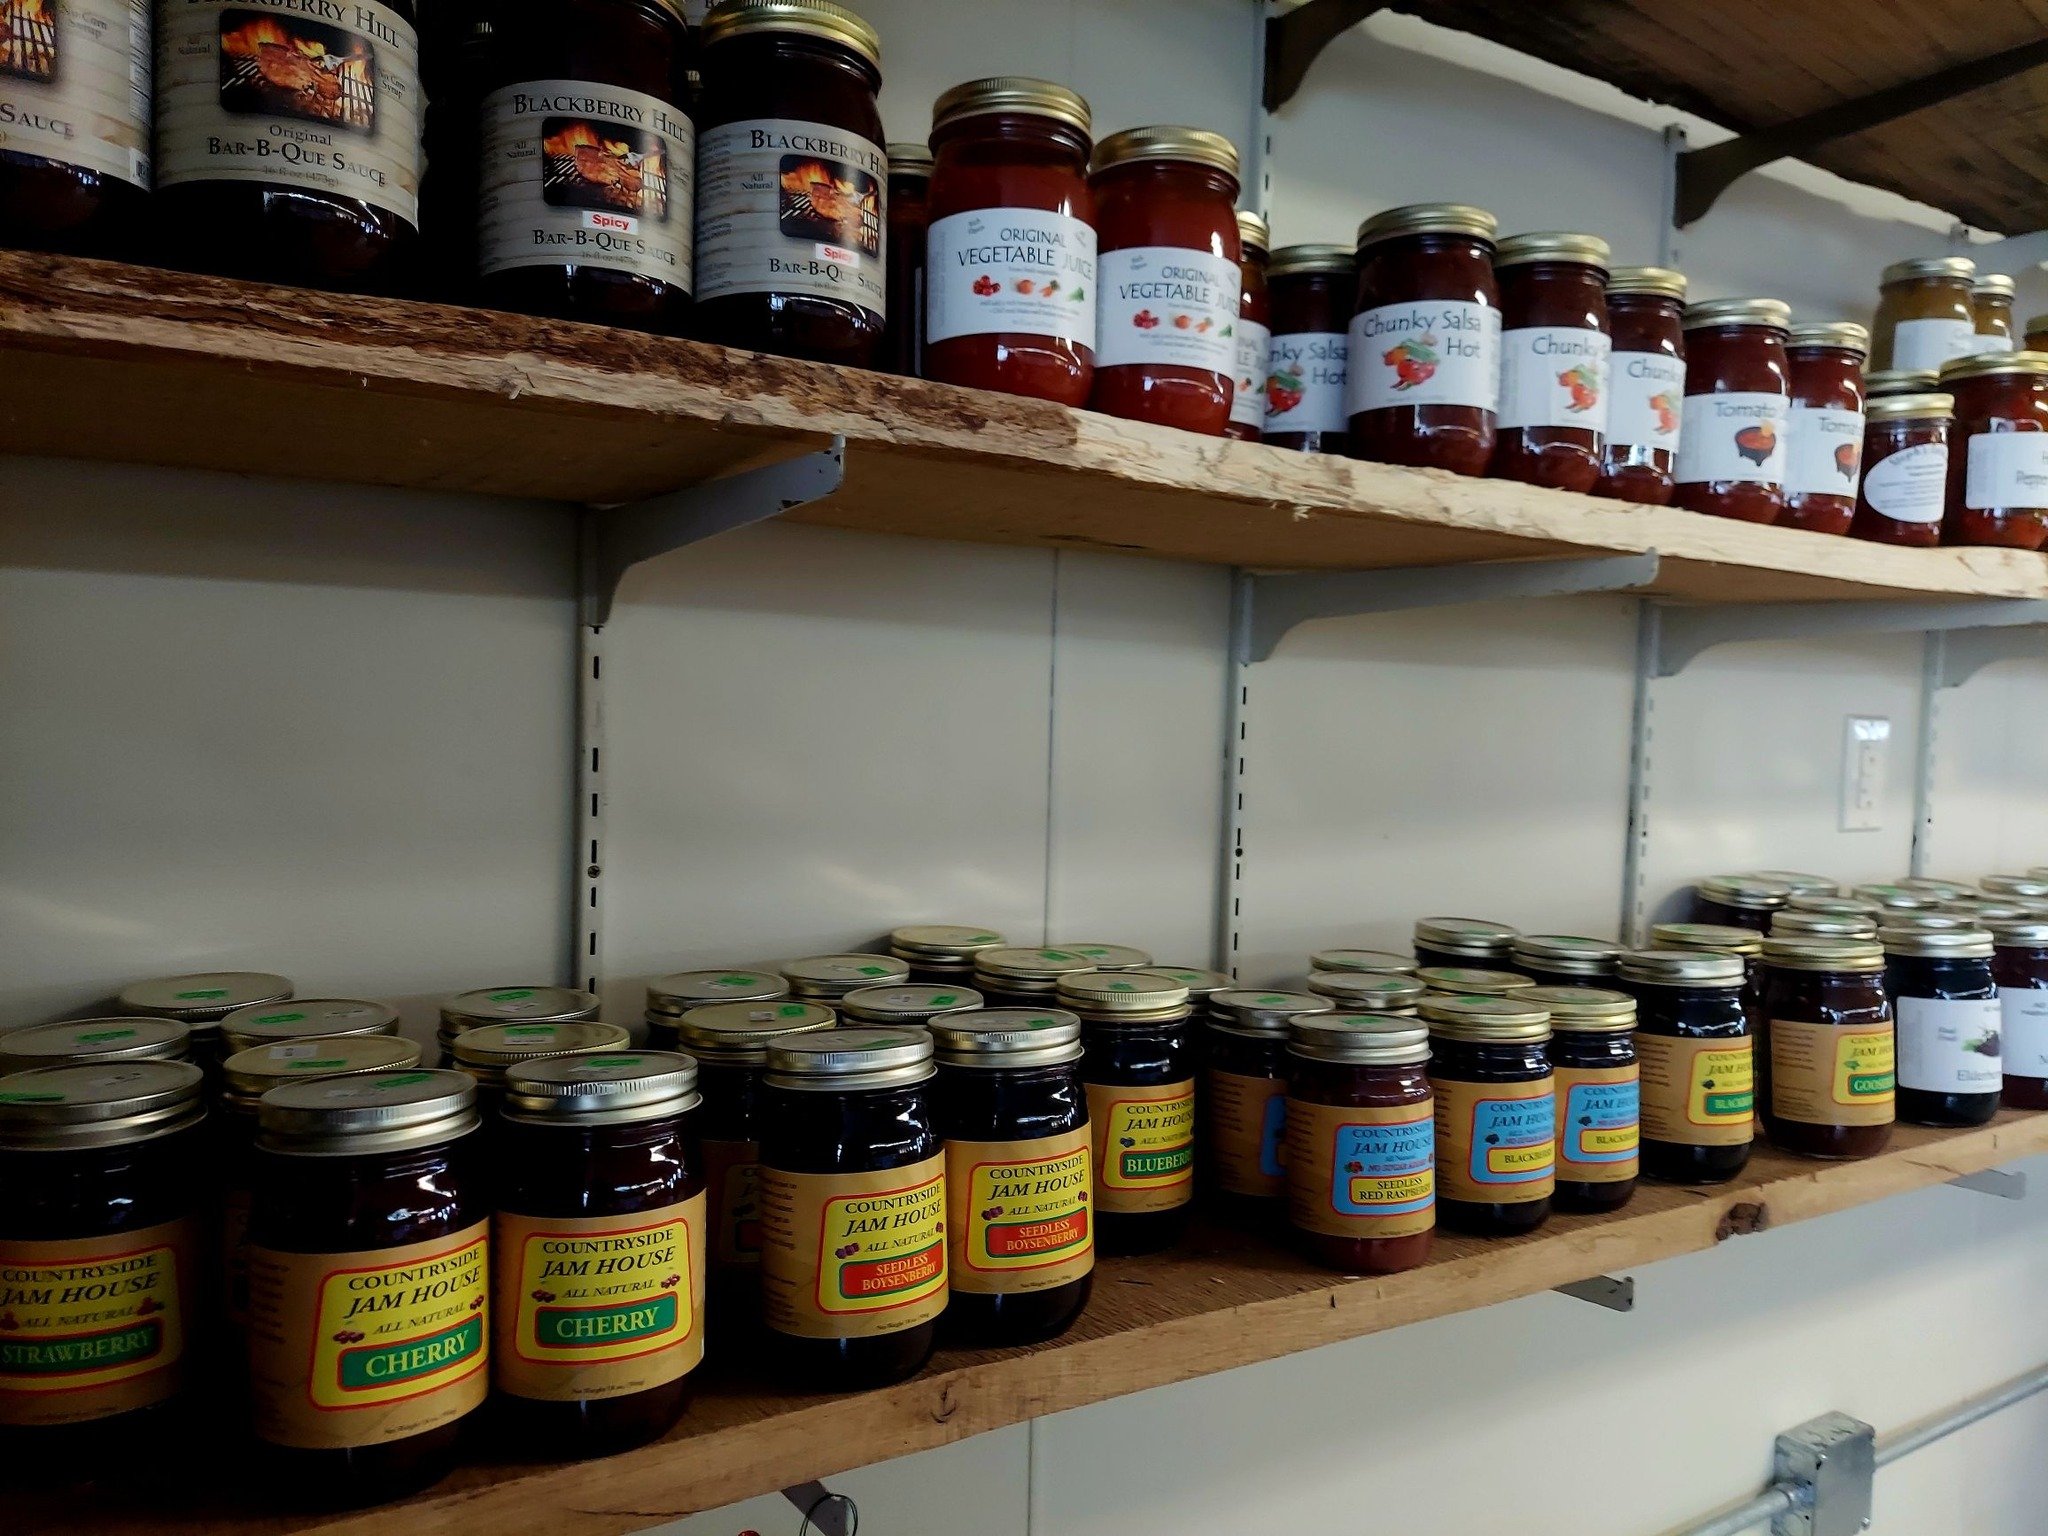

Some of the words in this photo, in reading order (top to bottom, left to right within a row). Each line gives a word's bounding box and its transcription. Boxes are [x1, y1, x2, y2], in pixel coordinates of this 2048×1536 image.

[353, 4, 400, 49] HILL
[0, 103, 75, 140] SAUCE
[513, 93, 645, 123] BLACKBERRY
[652, 108, 687, 143] HILL
[269, 123, 333, 147] Original
[750, 129, 866, 165] BLACKBERRY
[207, 136, 326, 166] BAR-B-QUE
[332, 151, 387, 188] SAUCE
[741, 181, 773, 190] Natural
[592, 213, 630, 231] Spicy
[532, 229, 632, 251] BAR-B-QUE
[636, 239, 676, 266] SAUCE
[1000, 228, 1067, 248] ORIGINAL
[957, 245, 1055, 267] VEGETABLE
[1061, 252, 1093, 281] JUICE
[1161, 265, 1220, 288] ORIGINAL
[1119, 283, 1211, 304] VEGETABLE
[1363, 310, 1437, 338] Chunky
[1441, 308, 1482, 332] Salsa
[1309, 339, 1348, 360] Salsa
[1447, 337, 1481, 359] Hot
[1312, 366, 1347, 385] Hot
[1581, 1099, 1615, 1112] JAM
[1123, 1118, 1158, 1132] JAM
[1487, 1115, 1523, 1129] JAM
[1349, 1141, 1388, 1157] JAM
[990, 1154, 1084, 1179] COUNTRYSIDE
[987, 1178, 1030, 1200] JAM
[1034, 1168, 1085, 1195] HOUSE
[1359, 1190, 1384, 1200] RED
[845, 1182, 941, 1214] COUNTRYSIDE
[1008, 1206, 1030, 1216] ALL
[1035, 1195, 1076, 1212] NATURAL
[842, 1214, 886, 1237] JAM
[893, 1198, 942, 1229] HOUSE
[1019, 1219, 1070, 1238] SEEDLESS
[543, 1228, 674, 1254] COUNTRYSIDE
[865, 1241, 889, 1253] ALL
[892, 1229, 935, 1249] NATURAL
[1006, 1227, 1081, 1251] BOYSENBERRY
[3, 1254, 157, 1283] COUNTRYSIDE
[348, 1247, 481, 1291] COUNTRYSIDE
[539, 1259, 589, 1279] JAM
[595, 1245, 676, 1275] HOUSE
[876, 1252, 929, 1276] SEEDLESS
[862, 1261, 937, 1291] BOYSENBERRY
[0, 1286, 54, 1306] JAM
[60, 1272, 161, 1304] HOUSE
[343, 1291, 402, 1319] JAM
[410, 1264, 482, 1306] HOUSE
[562, 1288, 588, 1299] ALL
[593, 1279, 655, 1296] NATURAL
[23, 1317, 50, 1328] ALL
[57, 1306, 135, 1325] NATURAL
[373, 1321, 403, 1335] ALL
[408, 1302, 466, 1328] NATURAL
[556, 1306, 660, 1338] CHERRY
[1, 1327, 155, 1364] STRAWBERRY
[365, 1329, 470, 1378] CHERRY
